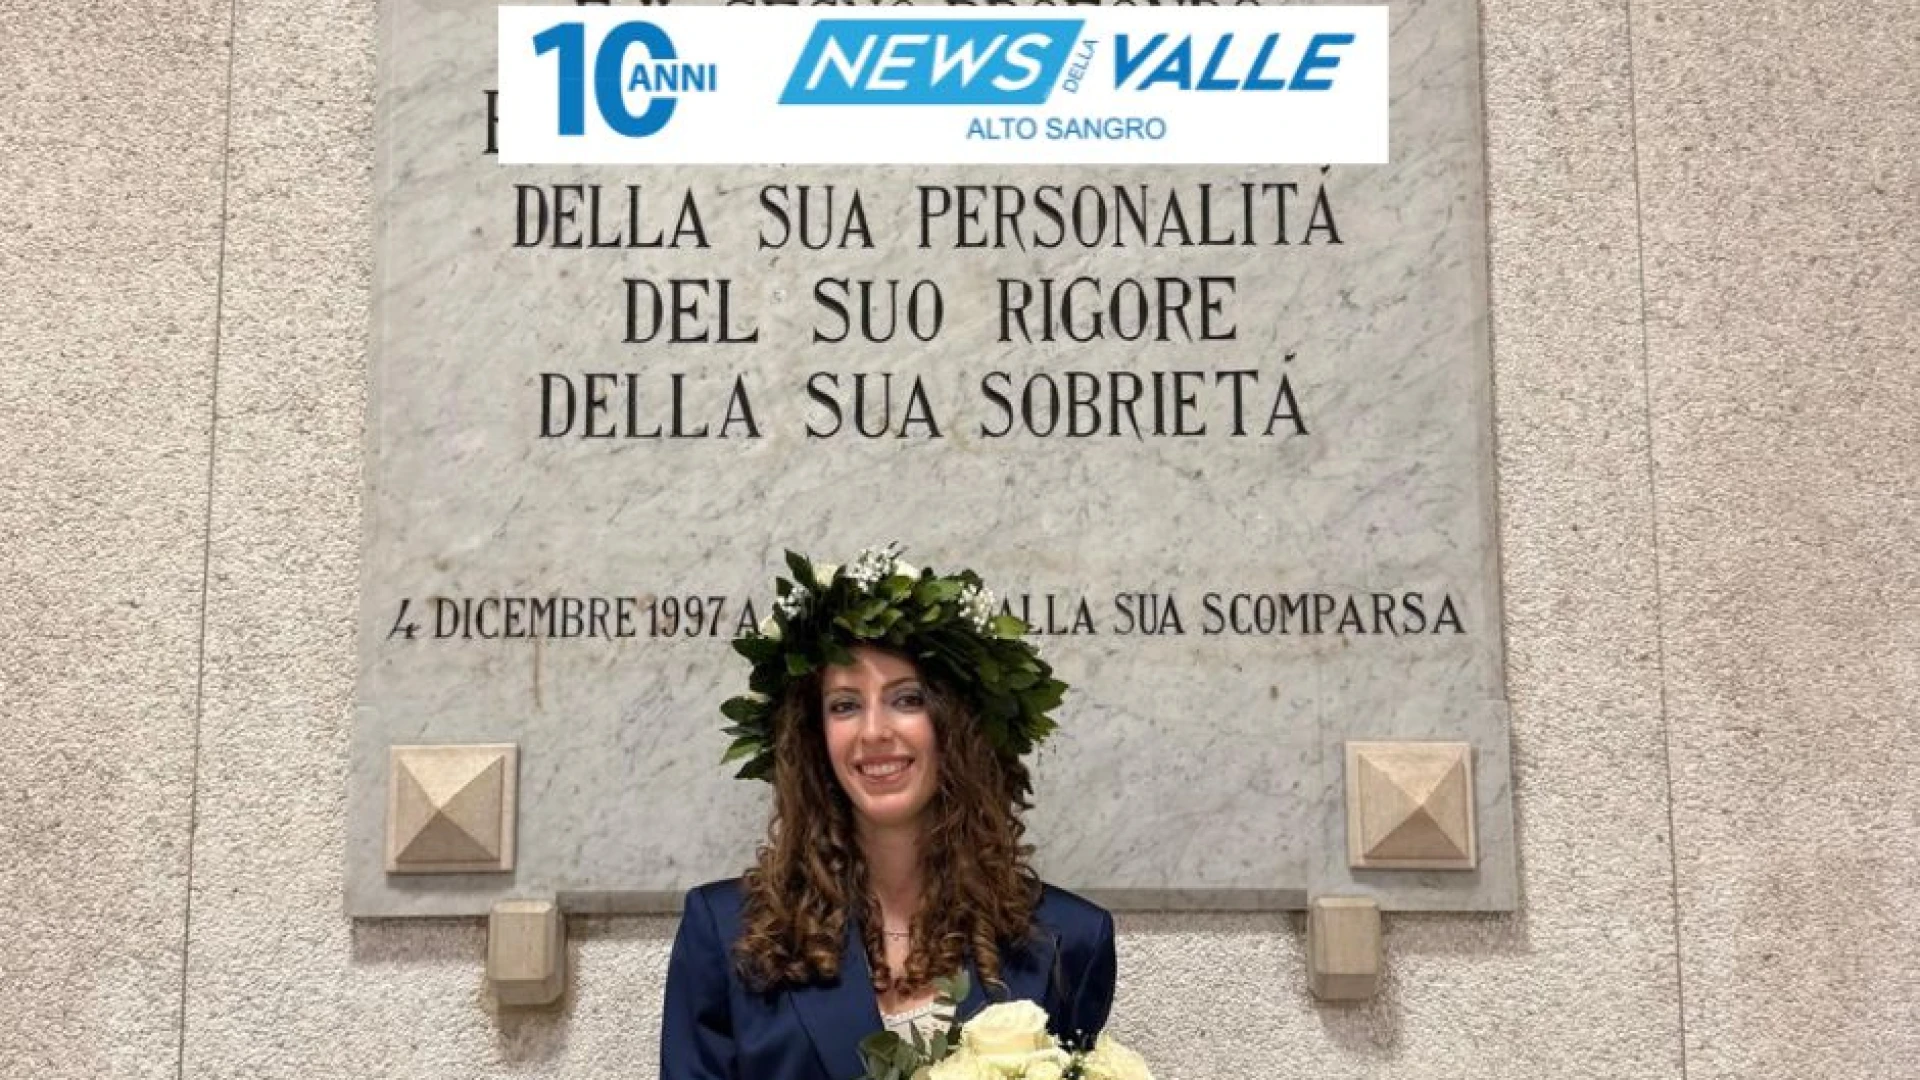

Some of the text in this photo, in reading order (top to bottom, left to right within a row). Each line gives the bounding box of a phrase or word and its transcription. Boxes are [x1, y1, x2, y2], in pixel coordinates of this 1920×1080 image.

[513, 184, 711, 249] DELLA
[758, 184, 875, 250] SUA
[622, 276, 1237, 344] DEL SUO RIGORE
[539, 372, 762, 439] DELLA
[805, 371, 944, 439] SUA
[386, 598, 422, 641] 4
[434, 597, 637, 642] DICEMBRE
[645, 596, 727, 638] 1997
[986, 593, 1097, 636] ALLA
[1113, 593, 1185, 636] SUA
[1202, 592, 1466, 637] SCOMPARSA
